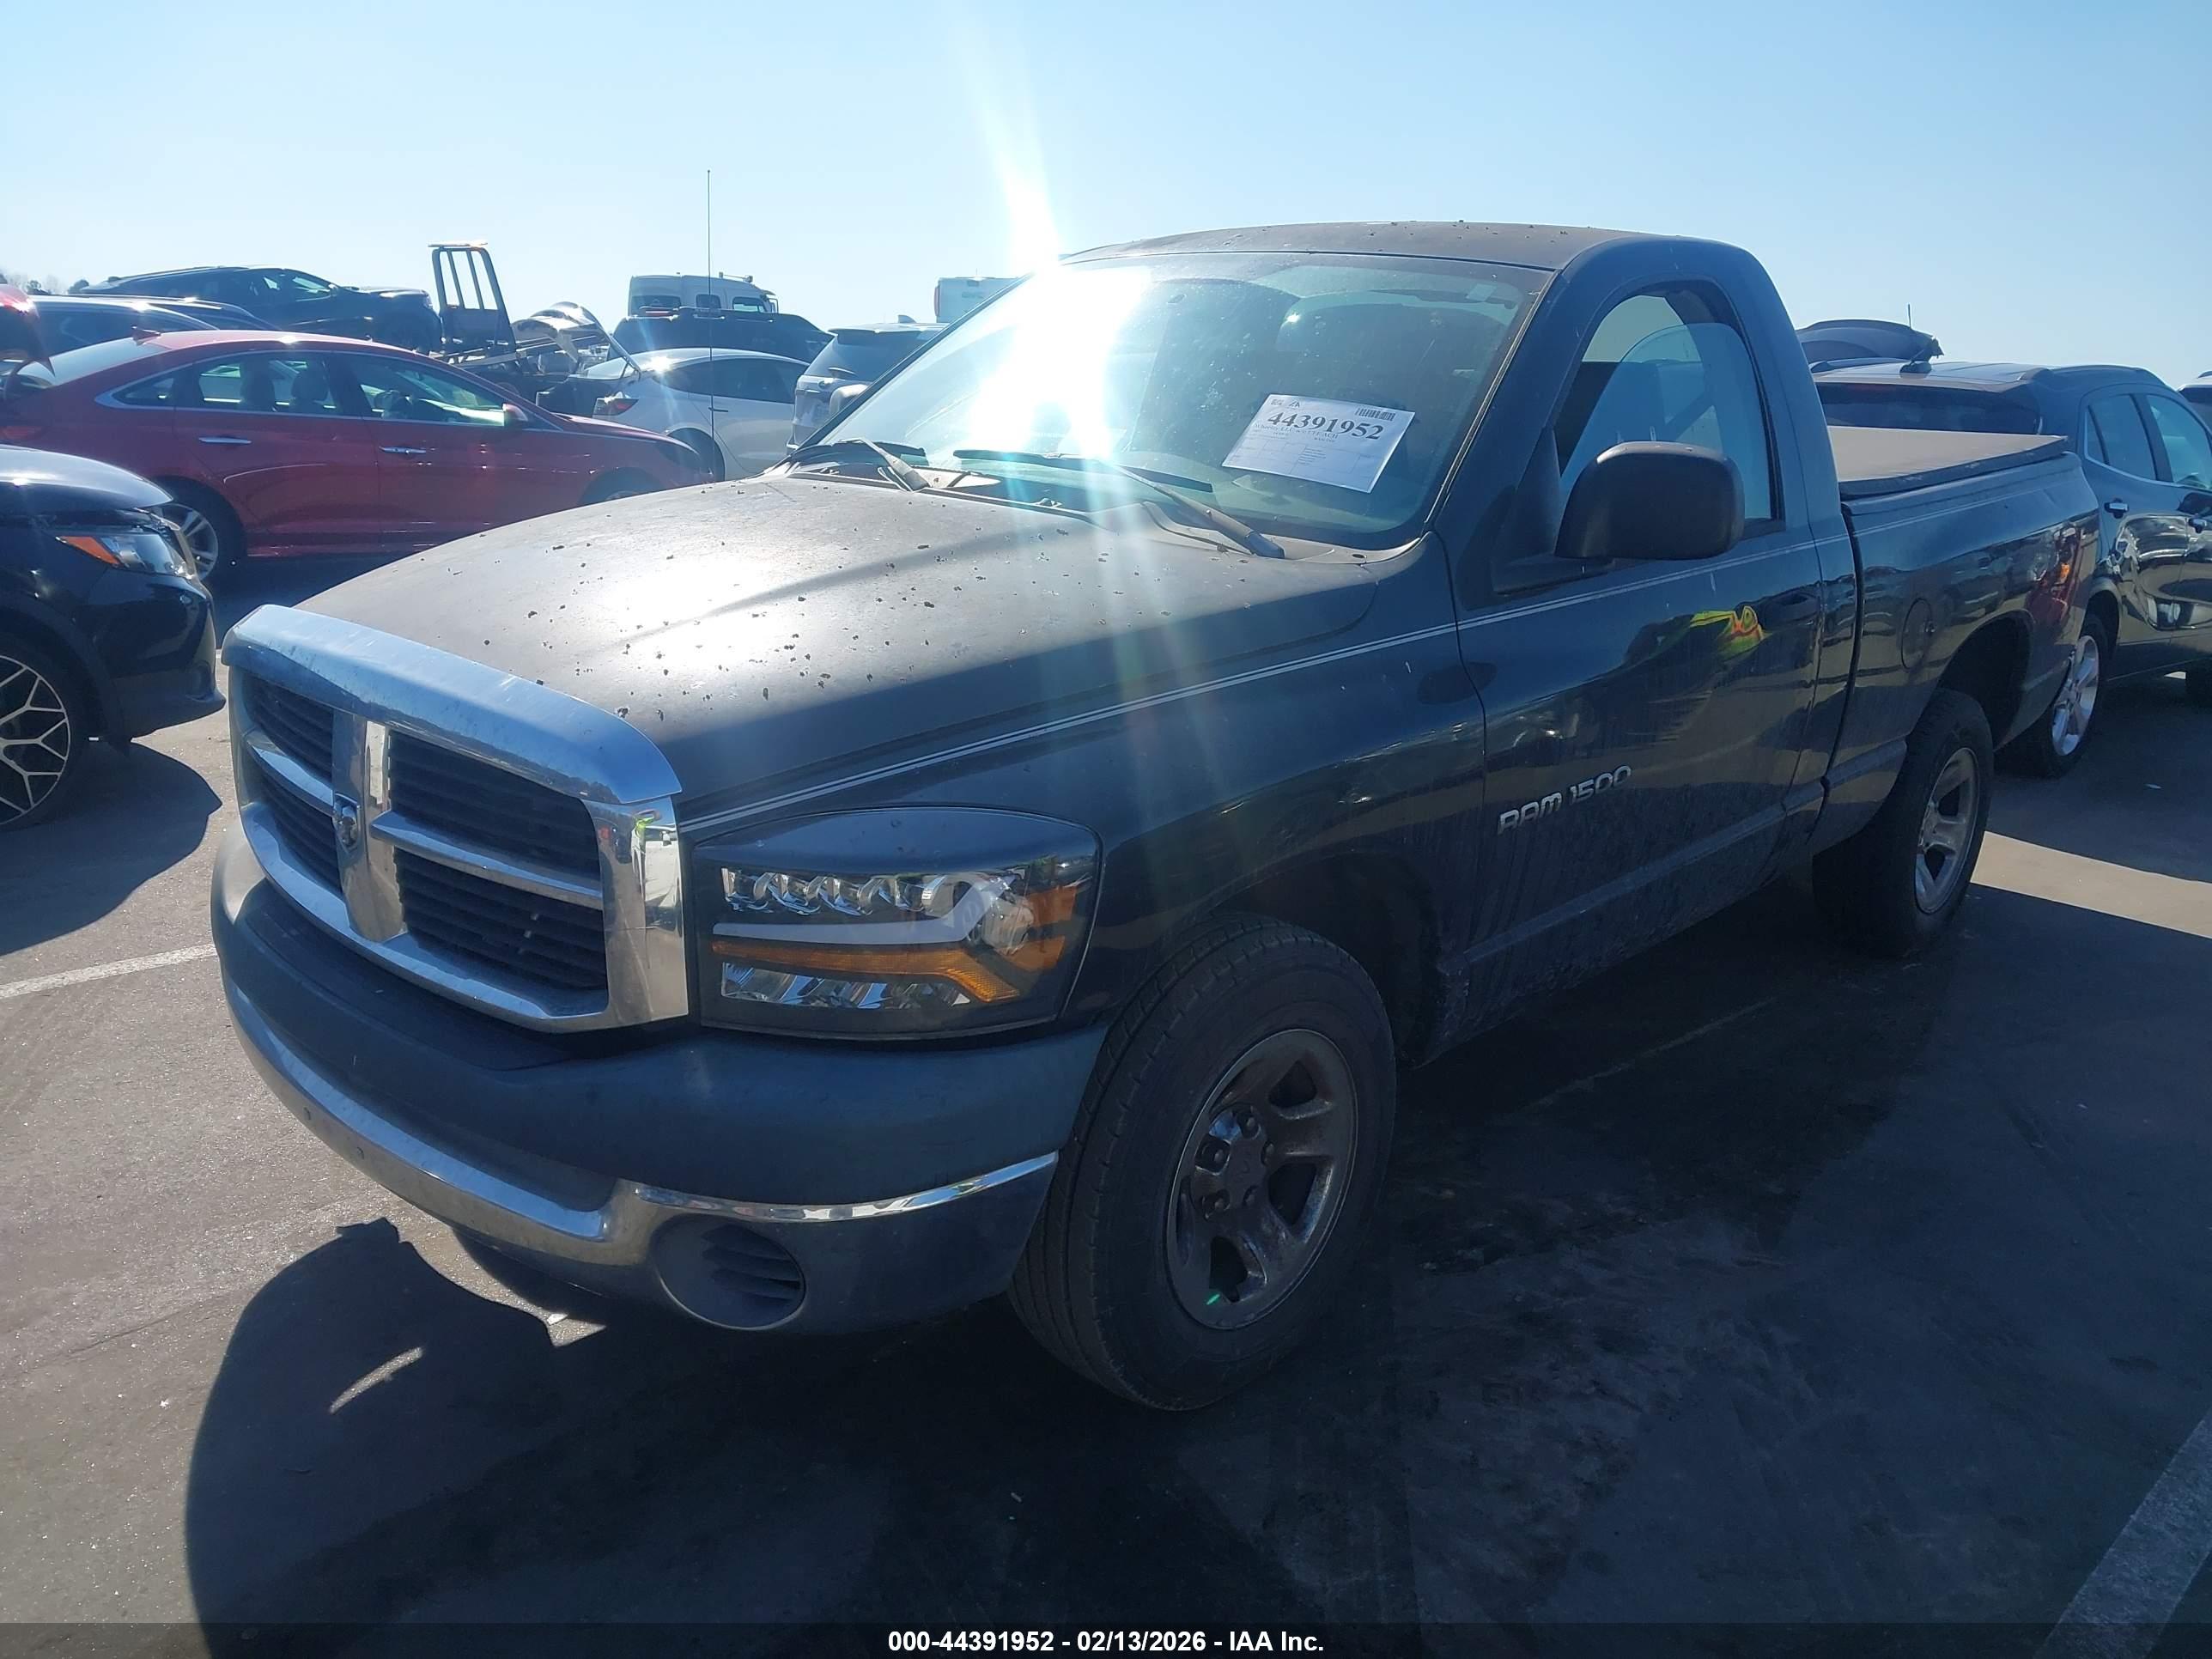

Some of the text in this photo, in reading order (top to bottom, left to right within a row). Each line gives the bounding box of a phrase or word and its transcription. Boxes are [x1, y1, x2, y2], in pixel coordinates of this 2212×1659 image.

[1267, 411, 1384, 440] 44391952
[1498, 765, 1632, 836] RAM 1500
